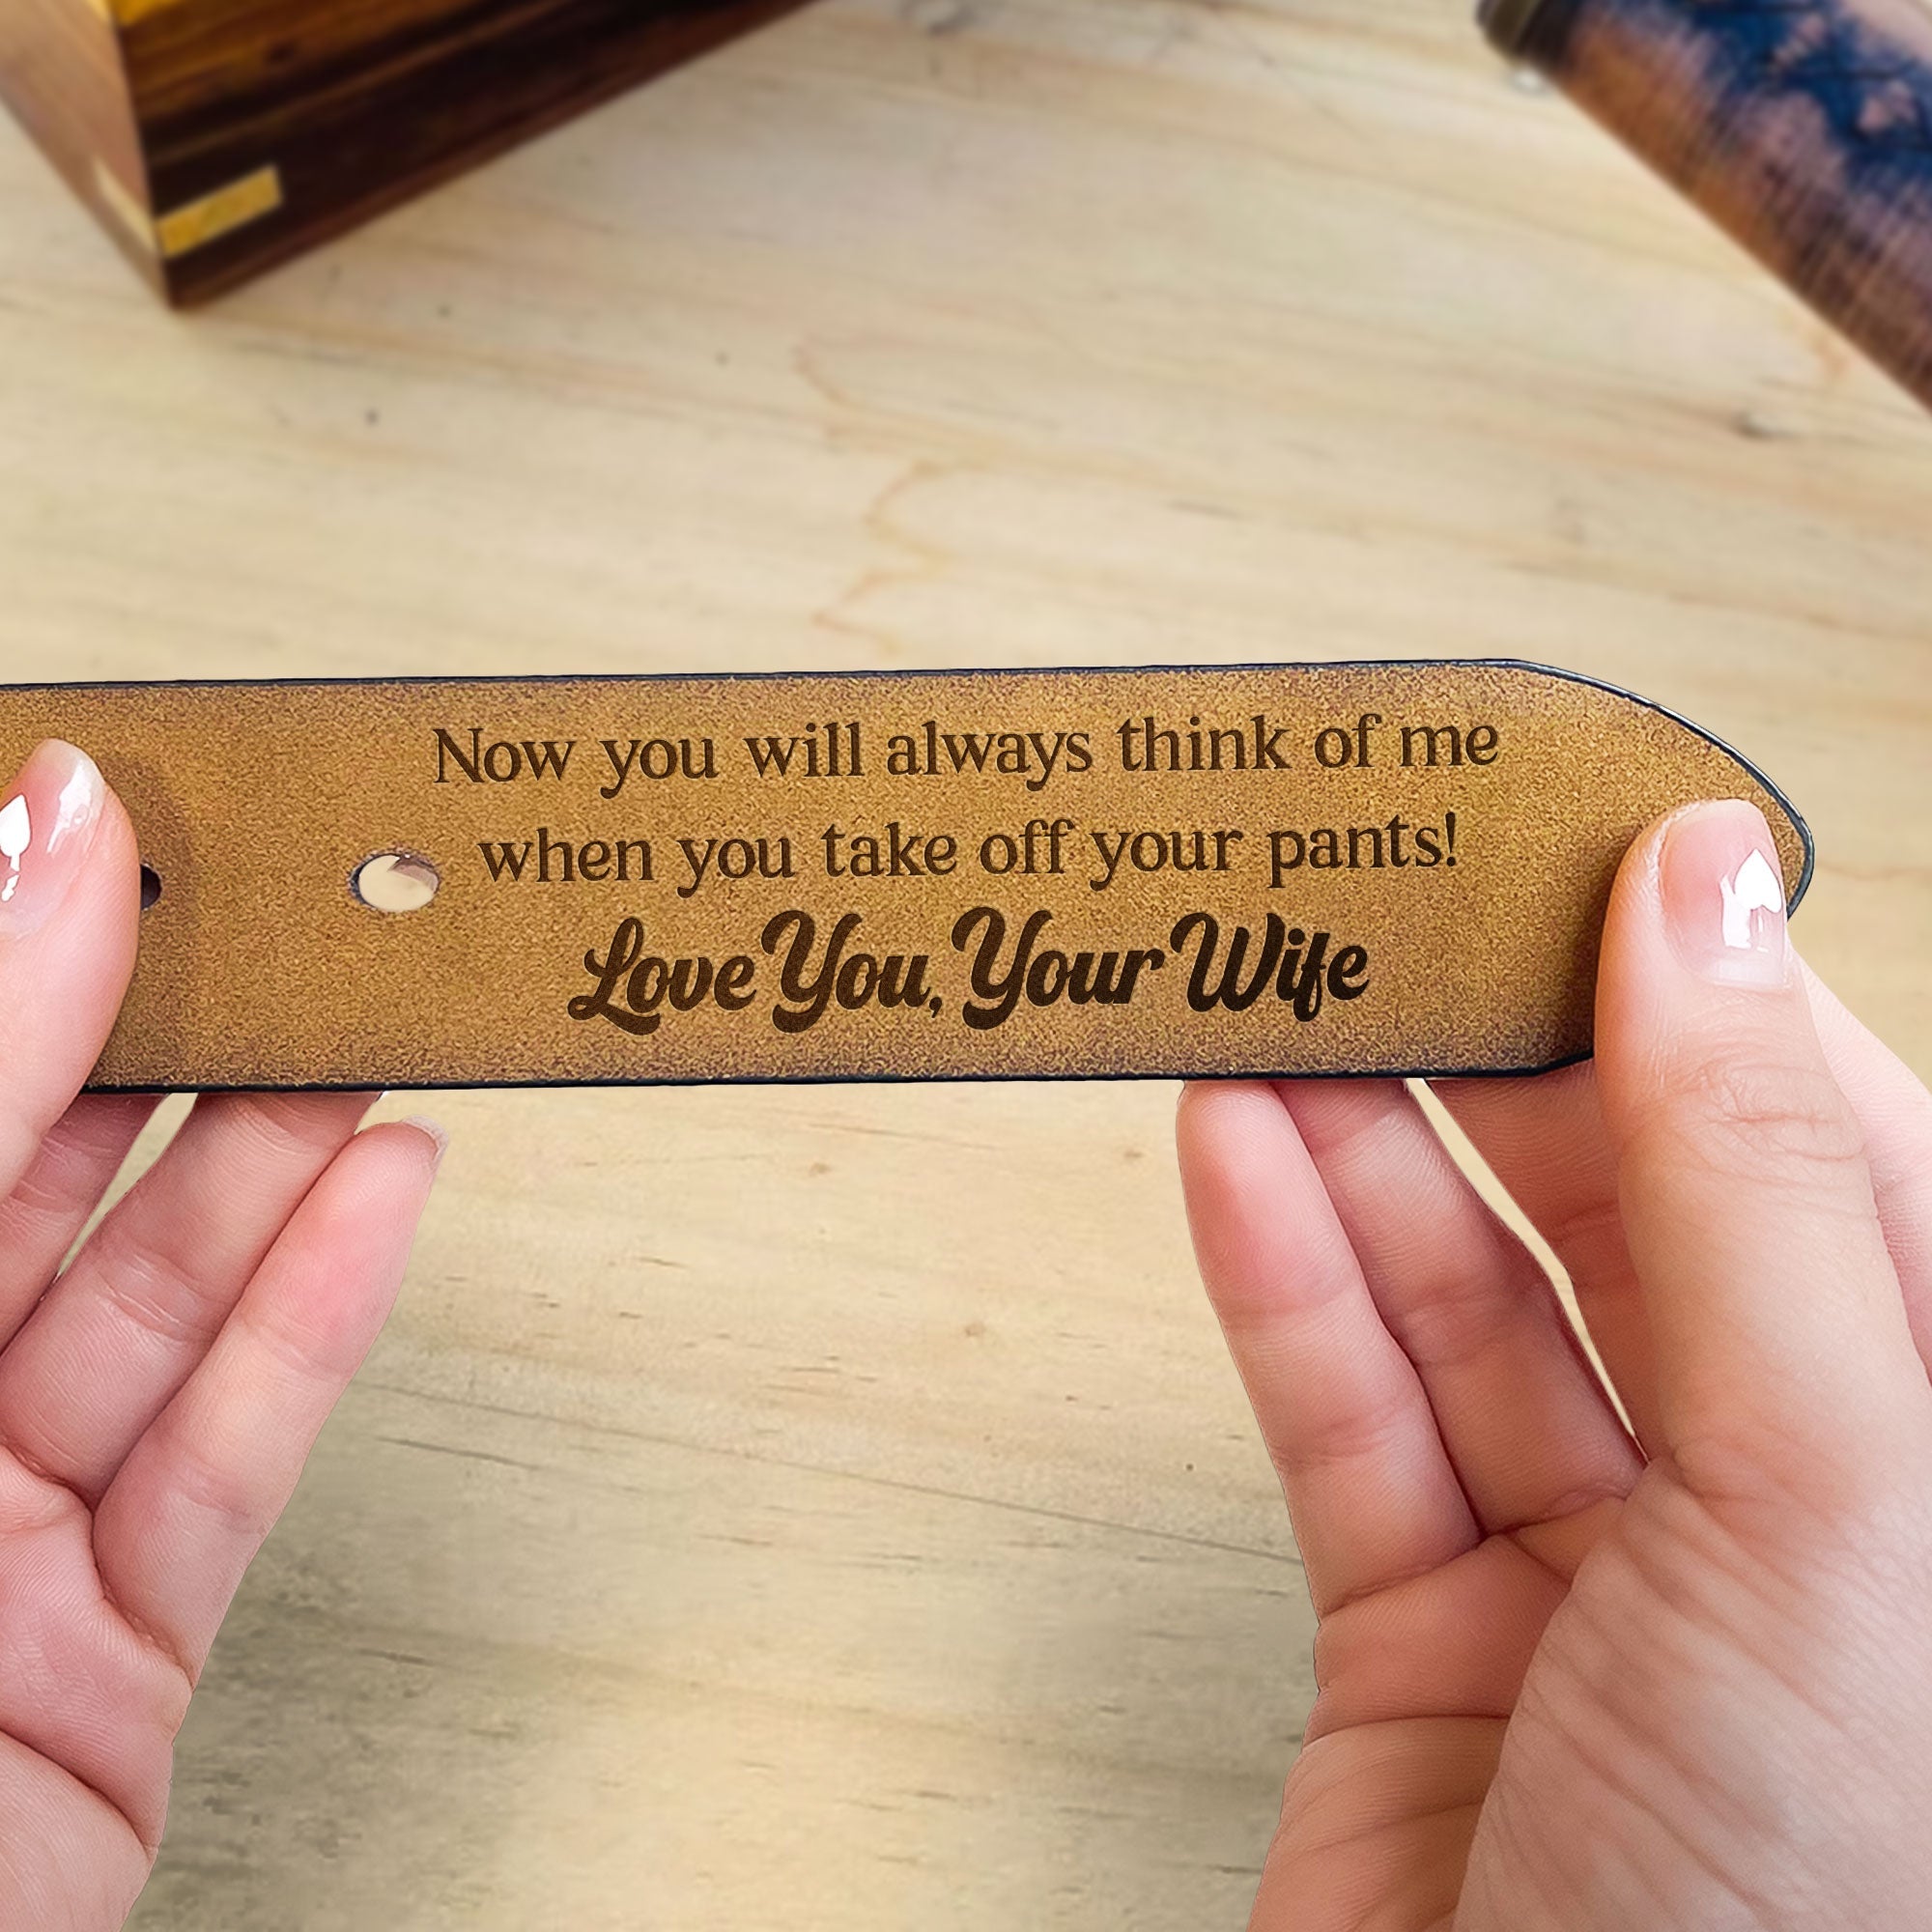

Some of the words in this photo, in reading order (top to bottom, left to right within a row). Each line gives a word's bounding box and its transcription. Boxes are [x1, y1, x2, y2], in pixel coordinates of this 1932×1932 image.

[433, 728, 577, 783] Now
[600, 738, 718, 799] you
[744, 722, 863, 777] will
[887, 721, 1093, 791] always
[1118, 716, 1291, 772] think
[1315, 714, 1382, 768] of
[1401, 724, 1498, 768] me
[478, 827, 653, 882] when
[677, 837, 795, 898] you
[821, 822, 957, 877] take
[980, 818, 1075, 874] off
[1090, 830, 1244, 892] your
[1266, 811, 1457, 889] pants!
[567, 917, 757, 1036] Love
[760, 910, 943, 1034] You,
[951, 906, 1166, 1031] Your
[1170, 912, 1370, 1023] Wife
